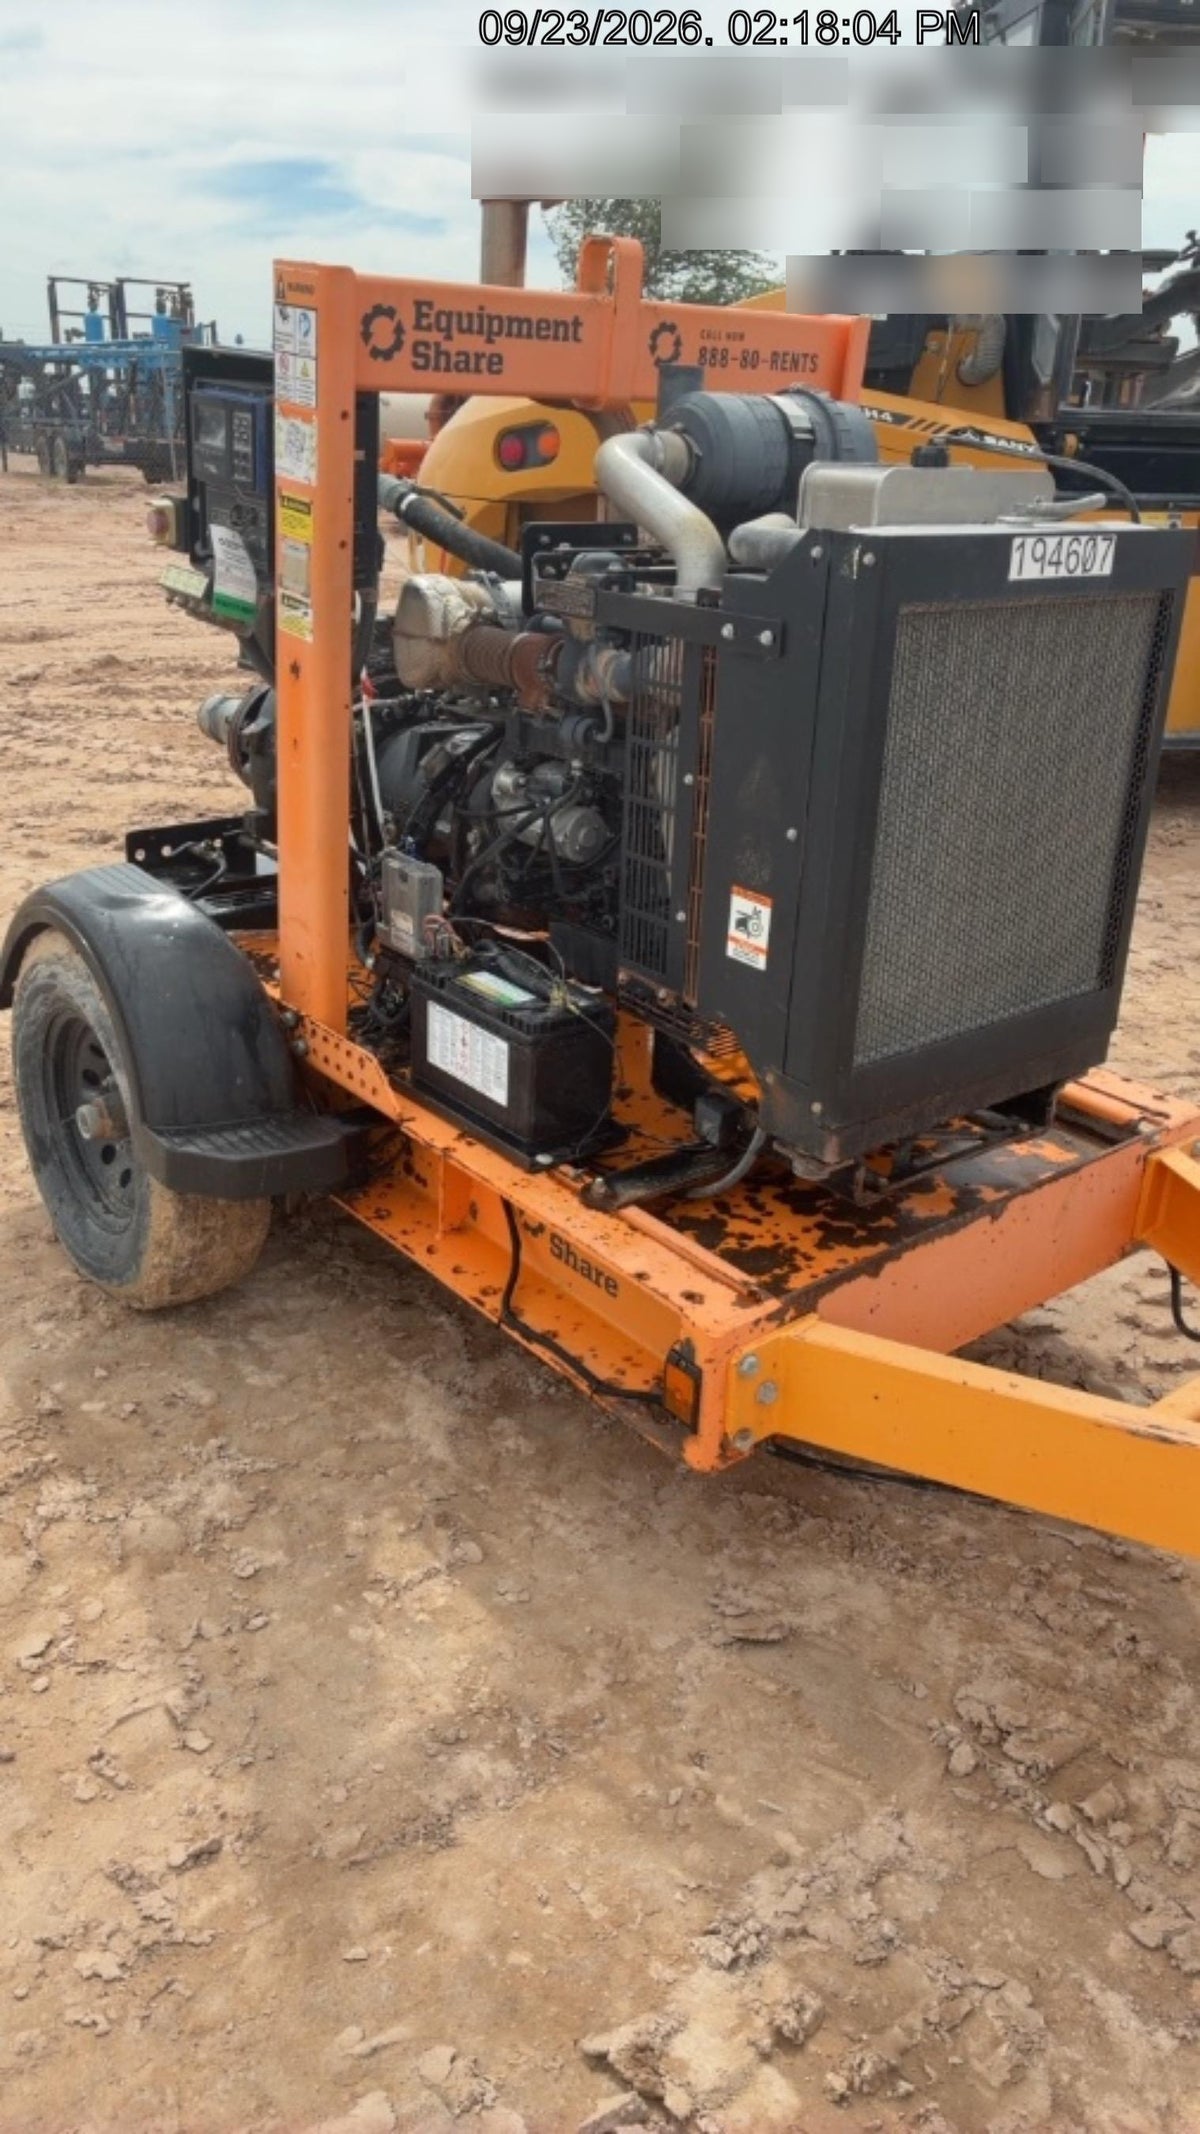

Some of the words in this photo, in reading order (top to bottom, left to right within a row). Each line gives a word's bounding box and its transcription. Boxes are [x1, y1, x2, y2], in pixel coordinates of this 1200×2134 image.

[412, 300, 584, 344] Equipment
[411, 340, 503, 375] Share
[698, 345, 819, 373] 888-80-RENTS
[1015, 537, 1114, 577] 194607
[549, 1232, 619, 1299] Share
